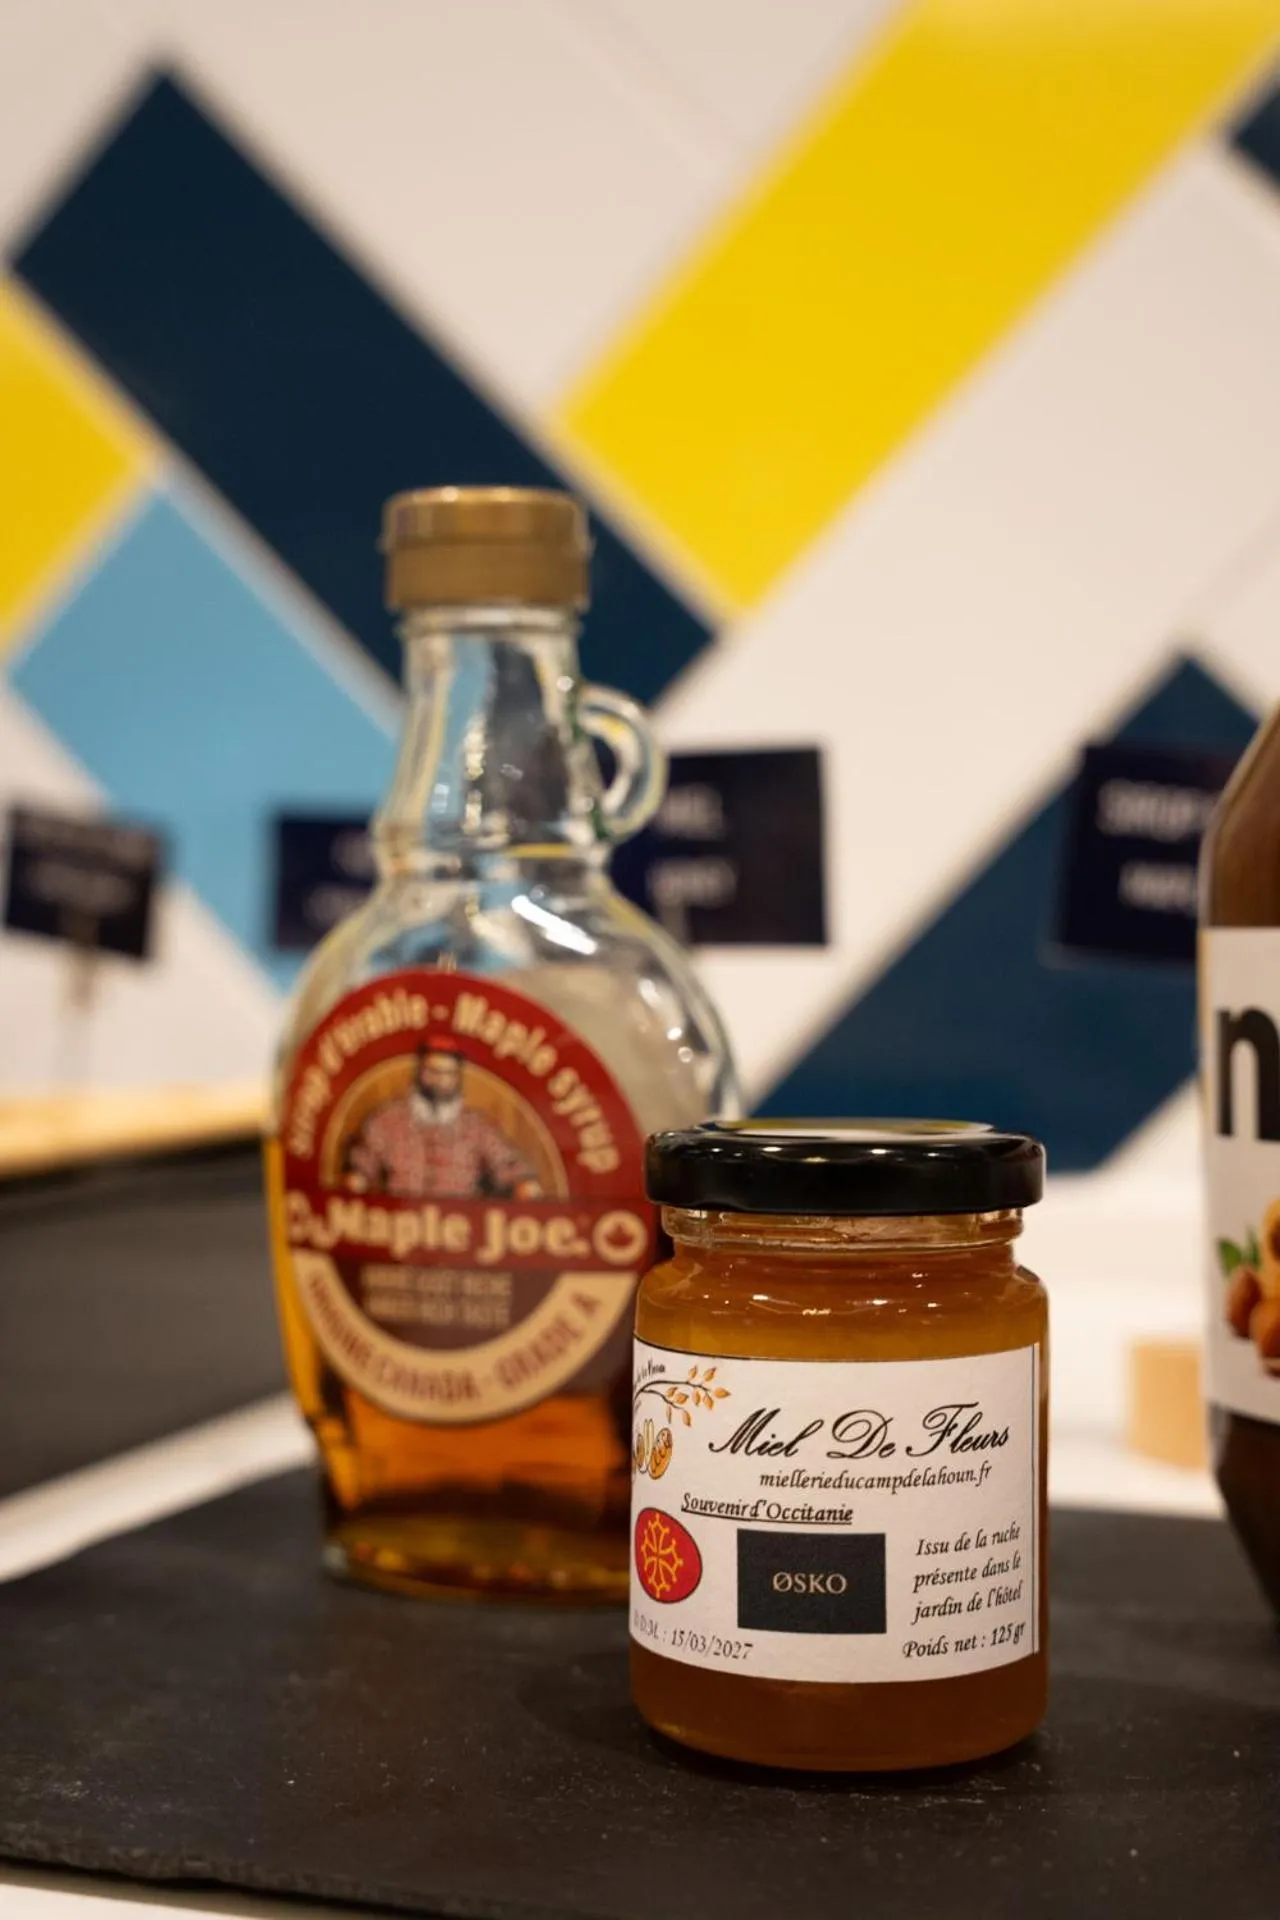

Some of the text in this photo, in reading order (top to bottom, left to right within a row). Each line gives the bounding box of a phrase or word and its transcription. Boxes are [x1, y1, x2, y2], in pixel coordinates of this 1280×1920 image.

[452, 991, 558, 1077] Maple
[328, 1195, 471, 1260] Maple
[492, 1310, 580, 1390] GRADE
[708, 1401, 1011, 1459] Miel De Fleurs
[759, 1460, 993, 1494] miellerieducampdelahoun.fr
[681, 1492, 853, 1522] Souvenir d'Occitanie
[915, 1520, 1021, 1556] Issu de la ruche
[772, 1571, 847, 1595] ØSKO
[912, 1550, 1021, 1594] présente dans le
[909, 1579, 1024, 1626] jardin de l'hôtel
[671, 1628, 754, 1659] 15/03/2027
[902, 1634, 949, 1659] Poids
[954, 1634, 978, 1653] net
